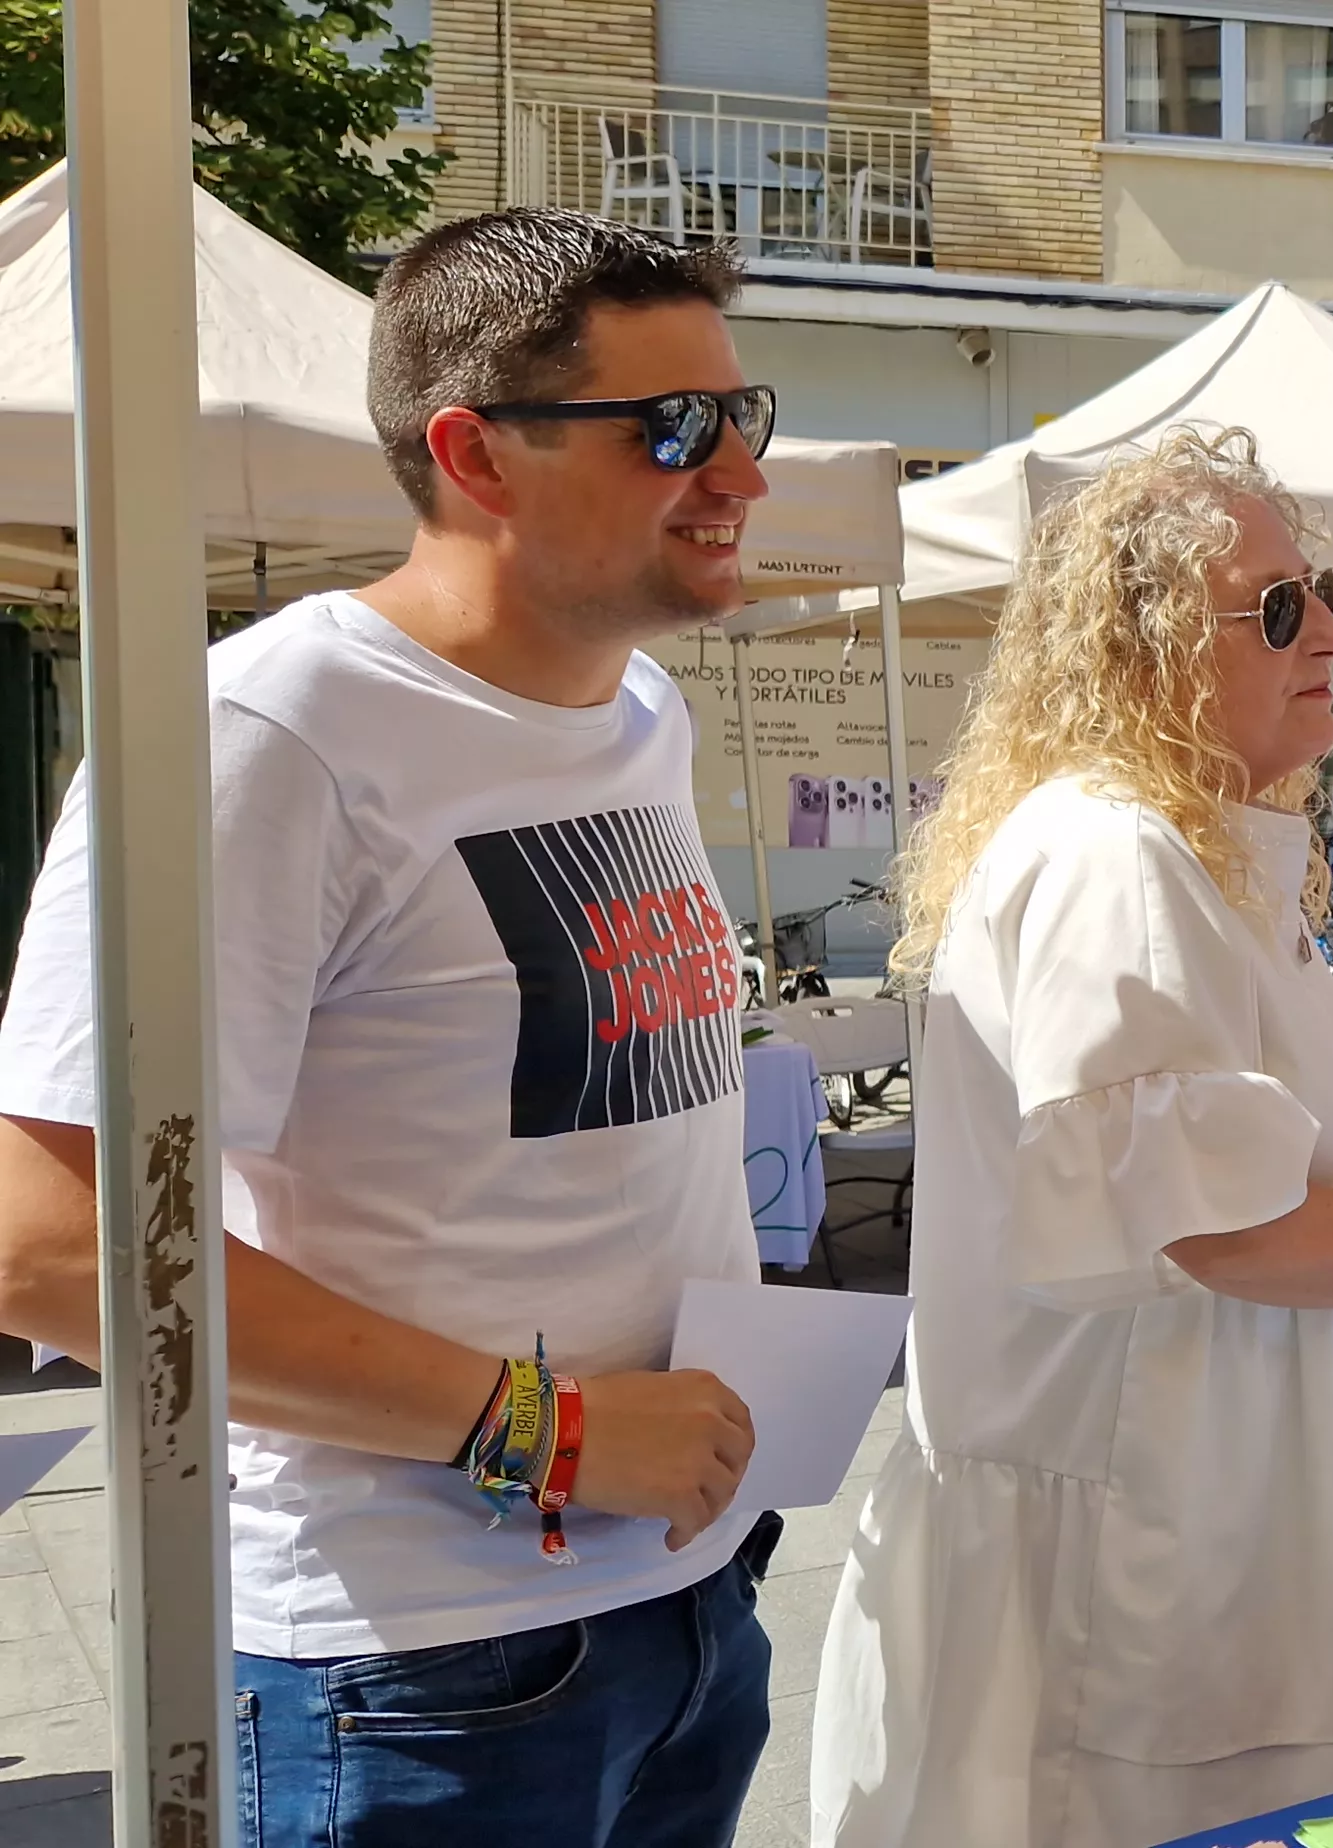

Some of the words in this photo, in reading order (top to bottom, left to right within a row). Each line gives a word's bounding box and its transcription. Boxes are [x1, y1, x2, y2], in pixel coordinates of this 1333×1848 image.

[715, 685, 728, 701] Y
[792, 668, 835, 685] TIPO
[839, 670, 865, 686] DE
[869, 671, 955, 688] MVILES
[597, 945, 737, 1043] JONES
[512, 1384, 538, 1438] AYERBE
